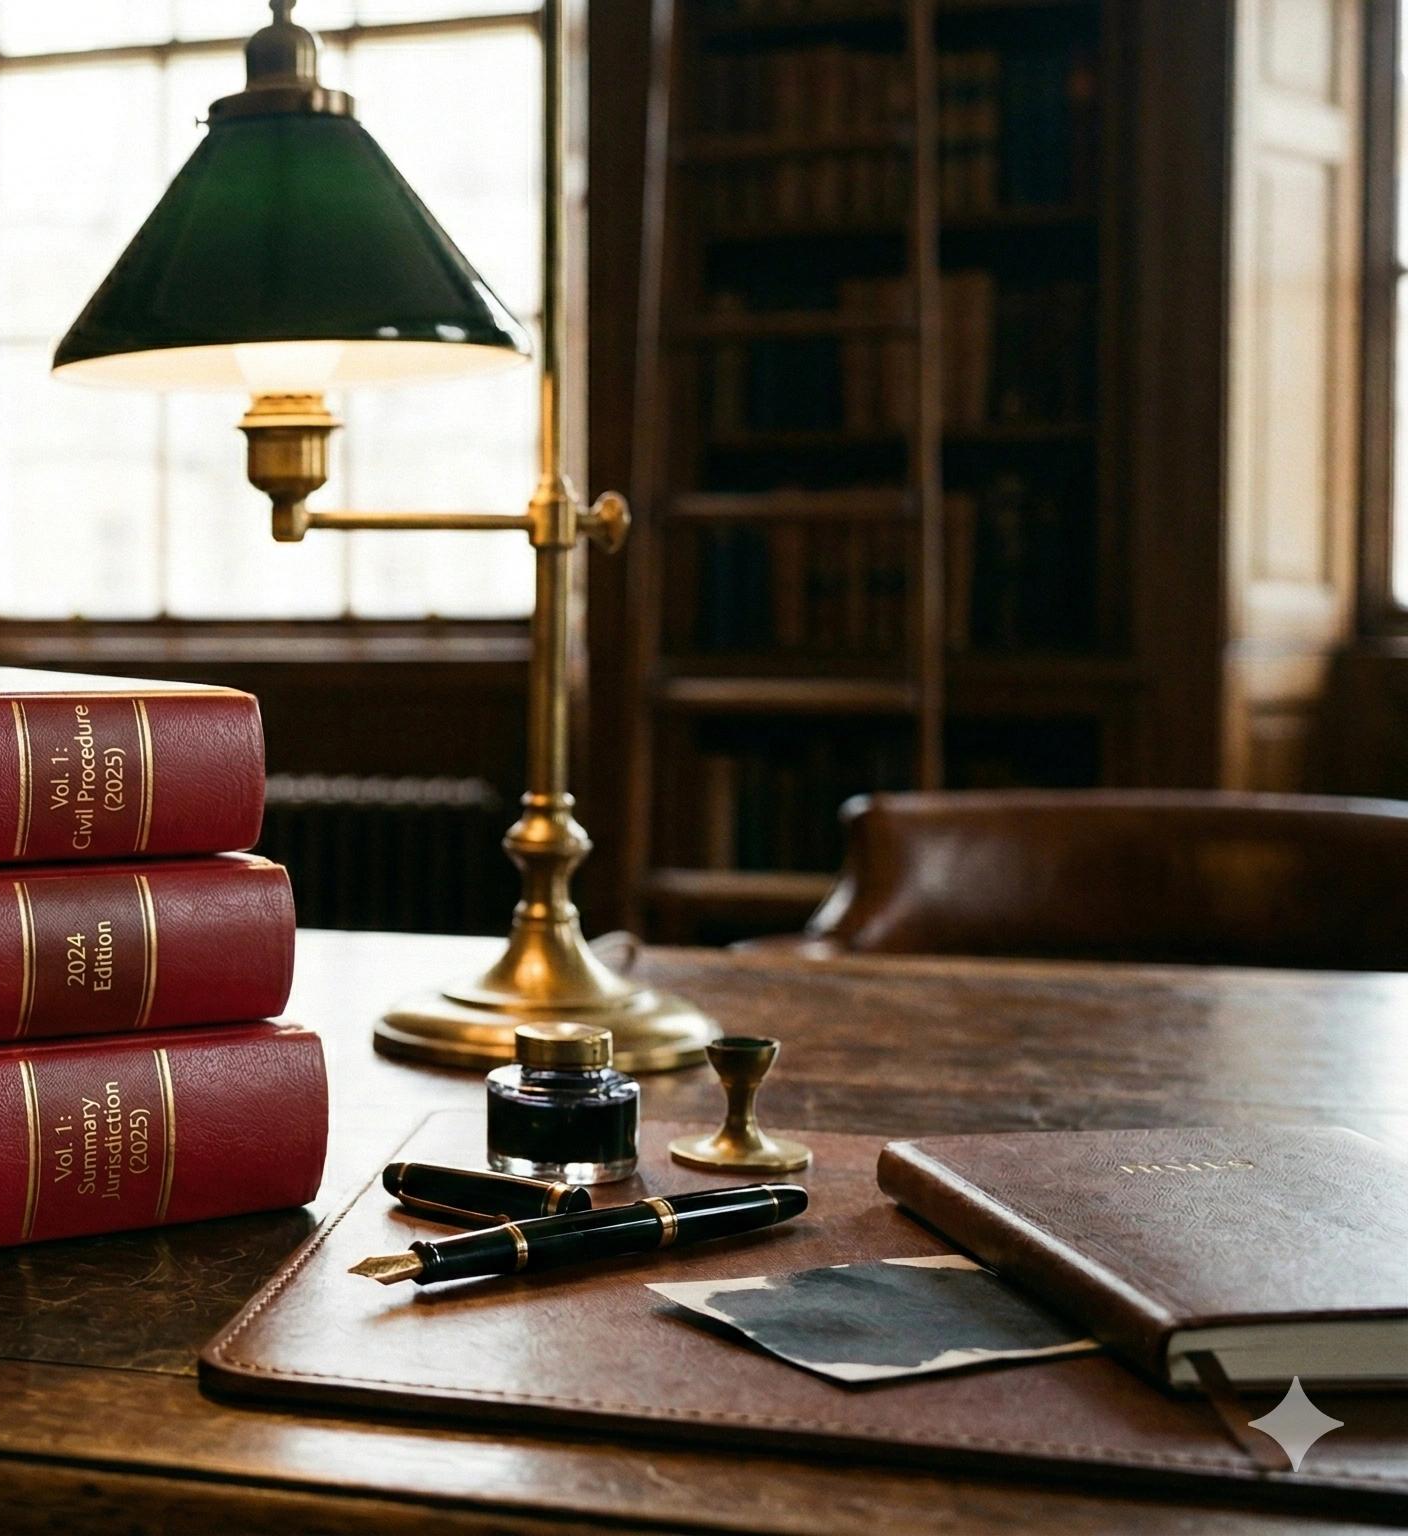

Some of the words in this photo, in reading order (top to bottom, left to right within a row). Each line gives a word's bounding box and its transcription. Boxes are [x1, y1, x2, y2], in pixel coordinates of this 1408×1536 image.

[51, 747, 68, 764] 1:
[73, 705, 95, 803] Procedure
[104, 747, 126, 812] (2025)
[50, 772, 69, 810] Vol.
[73, 810, 92, 850] Civil
[67, 933, 85, 987] 2024
[94, 920, 112, 990] Edition
[55, 1114, 72, 1134] 1:
[78, 1098, 100, 1194] Summary
[101, 1081, 122, 1199] Jurisdiction
[129, 1108, 151, 1173] (2025)
[55, 1142, 73, 1182] Vol.
